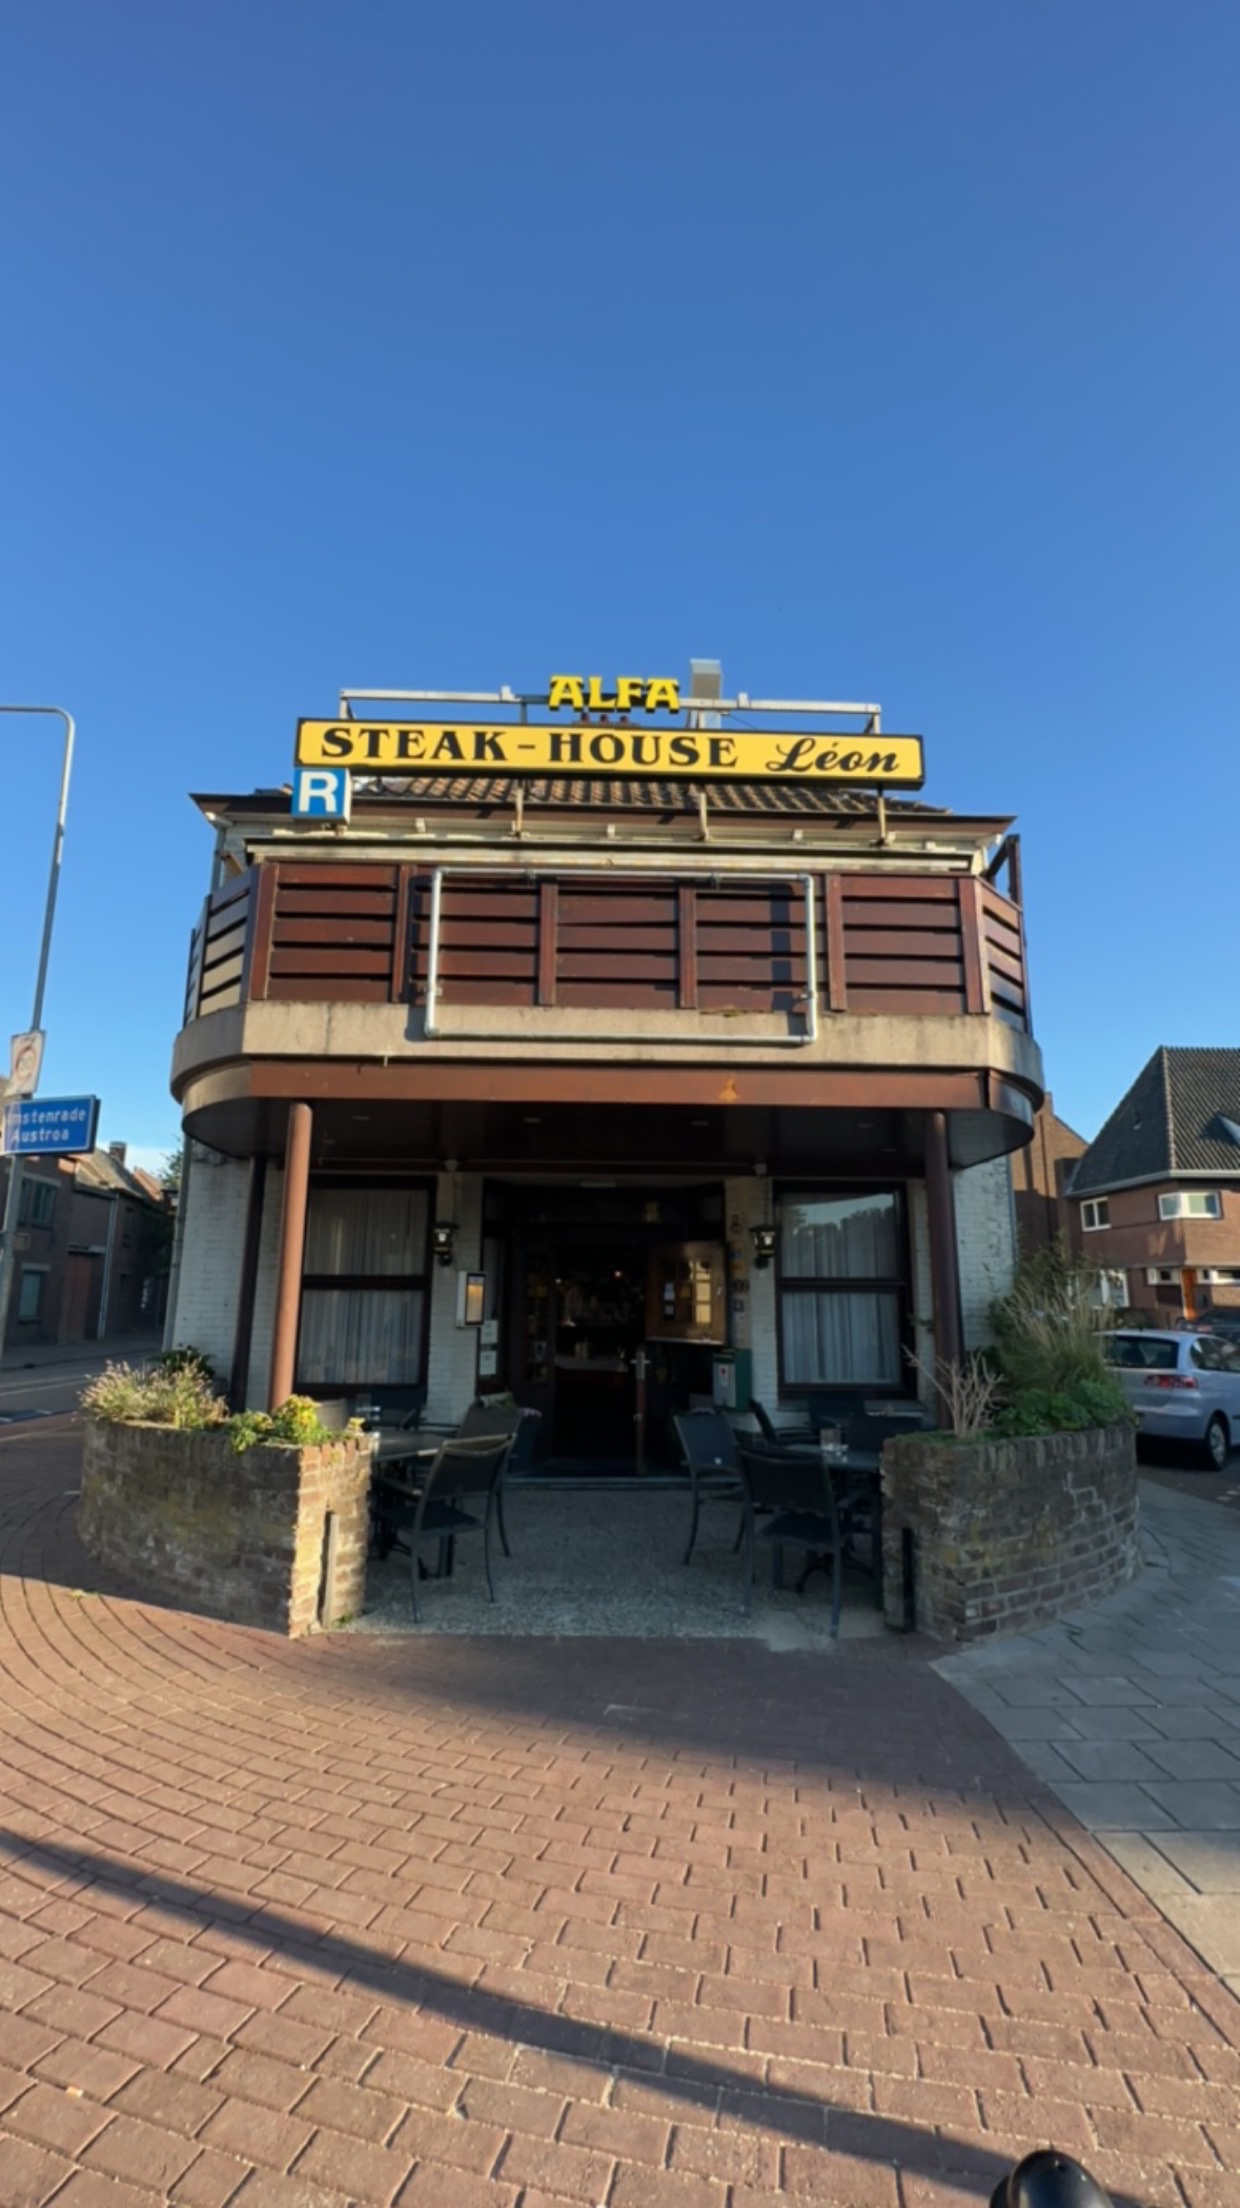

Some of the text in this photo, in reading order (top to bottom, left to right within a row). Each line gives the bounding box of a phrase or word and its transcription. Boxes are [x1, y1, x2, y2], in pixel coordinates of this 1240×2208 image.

[549, 676, 680, 712] ALFA
[765, 737, 900, 773] Léon
[299, 771, 339, 813] R
